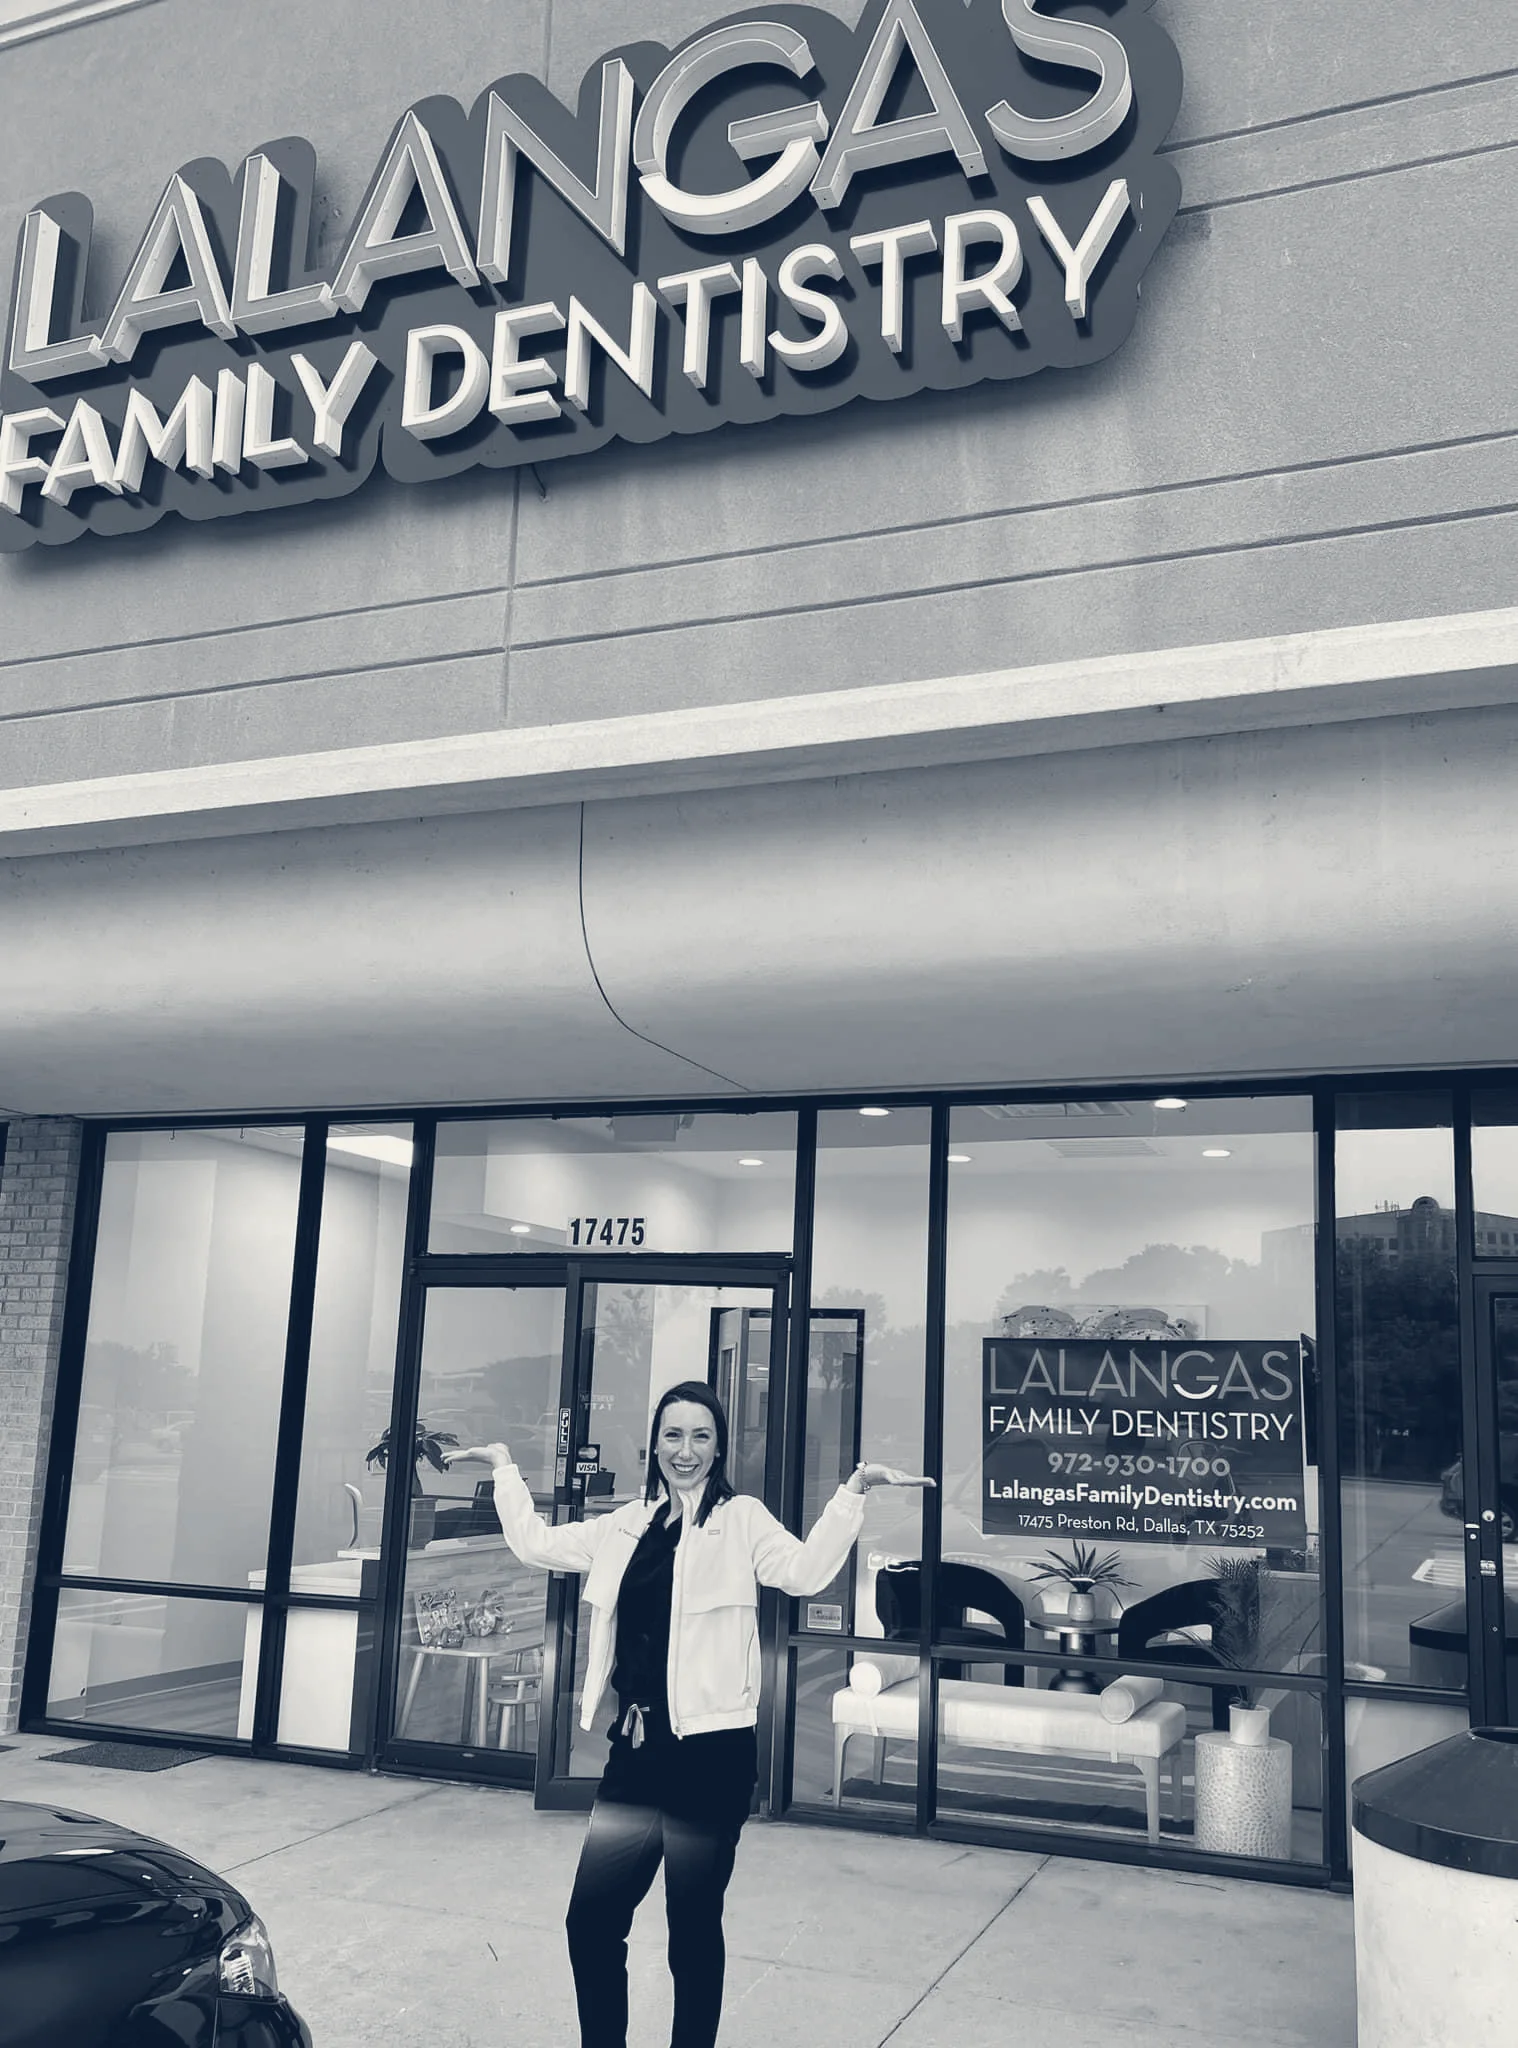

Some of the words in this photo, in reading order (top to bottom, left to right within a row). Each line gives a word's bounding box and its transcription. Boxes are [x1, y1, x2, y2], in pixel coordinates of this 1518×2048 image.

[9, 0, 1132, 382] LALANGAS
[0, 341, 379, 515] FAMILY
[401, 178, 1130, 441] DENTISTRY
[570, 1217, 645, 1246] 17475
[989, 1347, 1293, 1401] LALANGAS
[560, 1411, 569, 1444] PULL
[989, 1405, 1101, 1436] FAMILY
[1112, 1409, 1294, 1441] DENTISTRY
[578, 1463, 597, 1472] VISA
[1047, 1452, 1231, 1478] 972-930-1700
[989, 1479, 1297, 1514] LalangasFamilyDentistry.com
[1018, 1514, 1054, 1529] 17475
[1057, 1513, 1111, 1530] Preston
[1116, 1516, 1139, 1533] Rd,
[1144, 1517, 1191, 1535] Dallas,
[1194, 1520, 1216, 1535] TX
[1220, 1524, 1265, 1539] 75252
